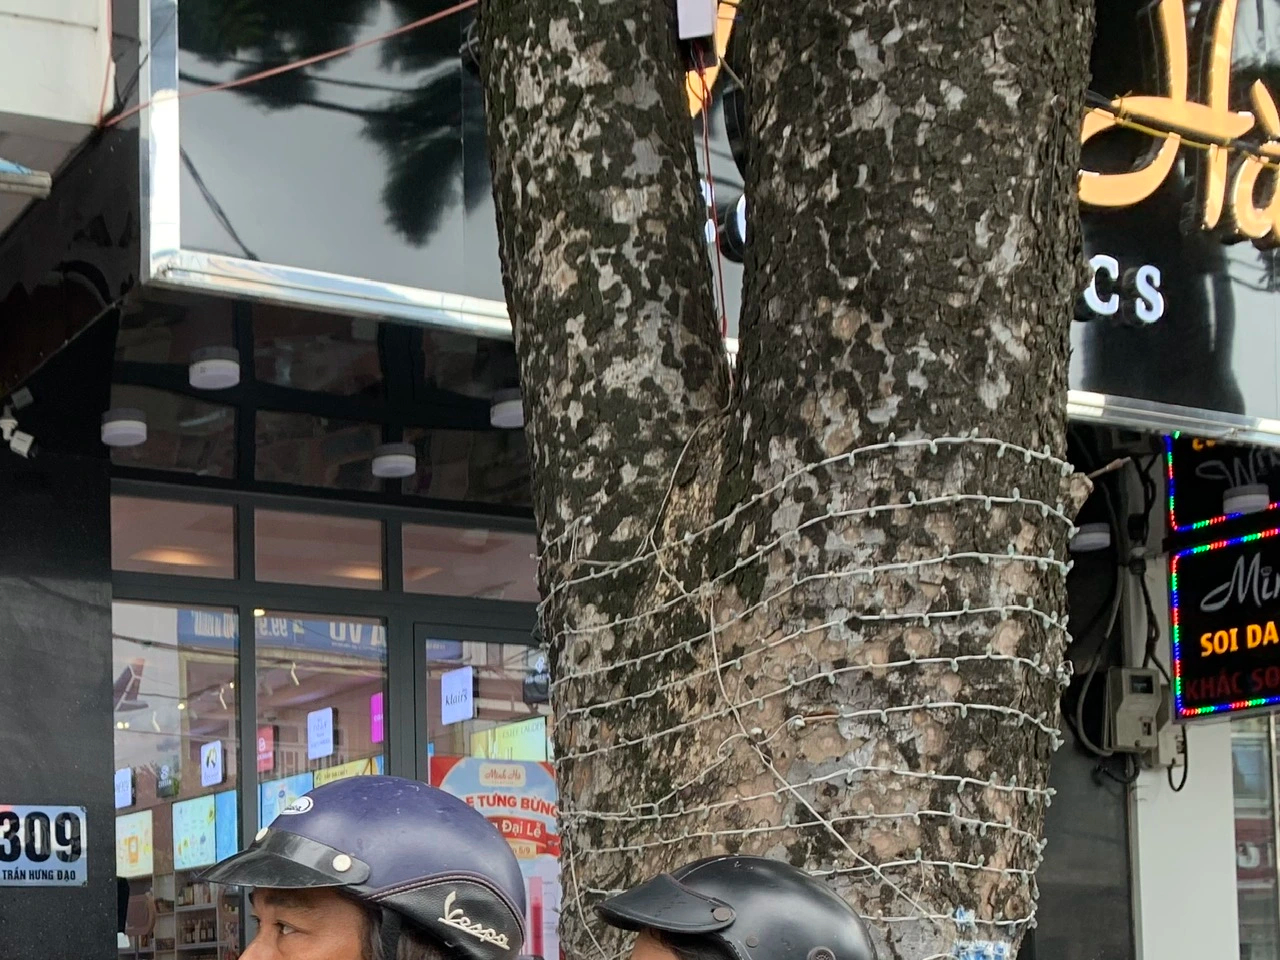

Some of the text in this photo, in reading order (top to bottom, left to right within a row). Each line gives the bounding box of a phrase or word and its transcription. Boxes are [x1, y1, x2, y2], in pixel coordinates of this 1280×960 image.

[1199, 620, 1279, 657] SOI DA
[501, 819, 523, 837] Đại
[437, 890, 511, 950] Vespa
